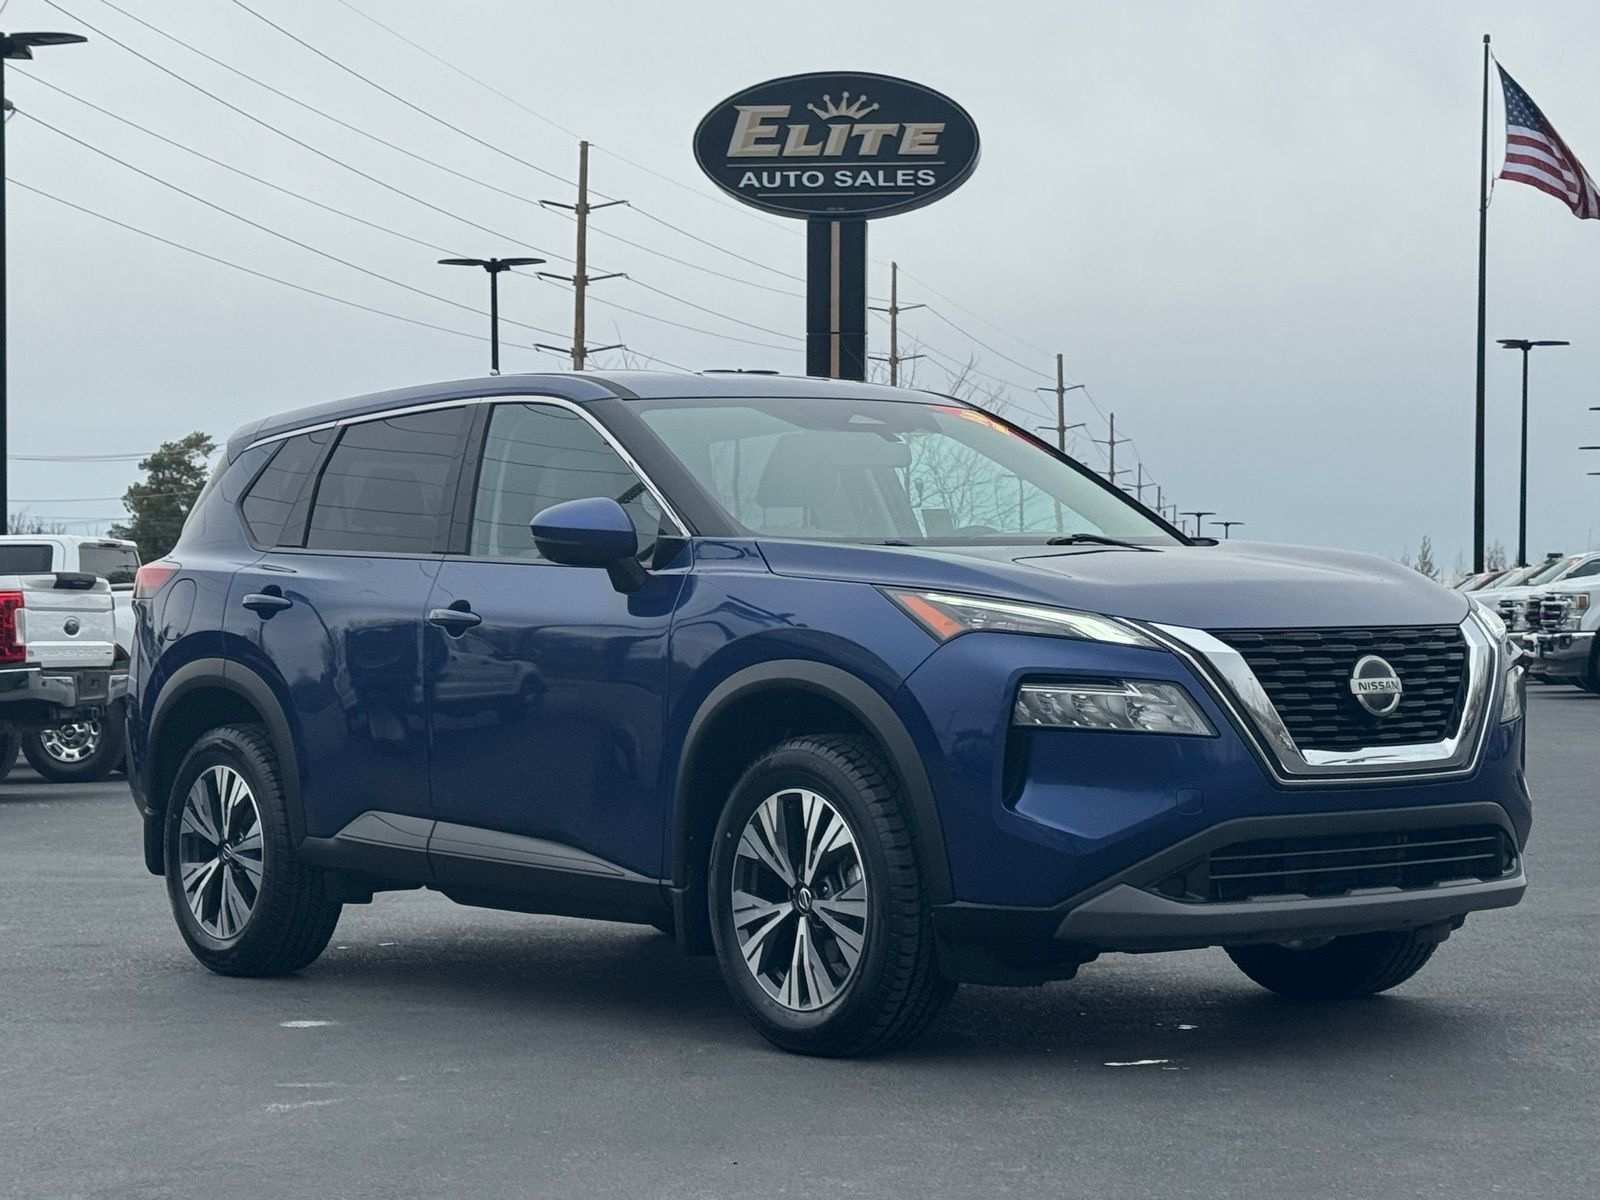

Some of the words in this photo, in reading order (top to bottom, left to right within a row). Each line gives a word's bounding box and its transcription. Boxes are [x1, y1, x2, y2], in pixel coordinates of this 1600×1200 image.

[726, 105, 945, 157] ELITE
[738, 171, 825, 188] AUTO
[834, 169, 936, 187] SALES
[1358, 681, 1399, 691] NISSAN
